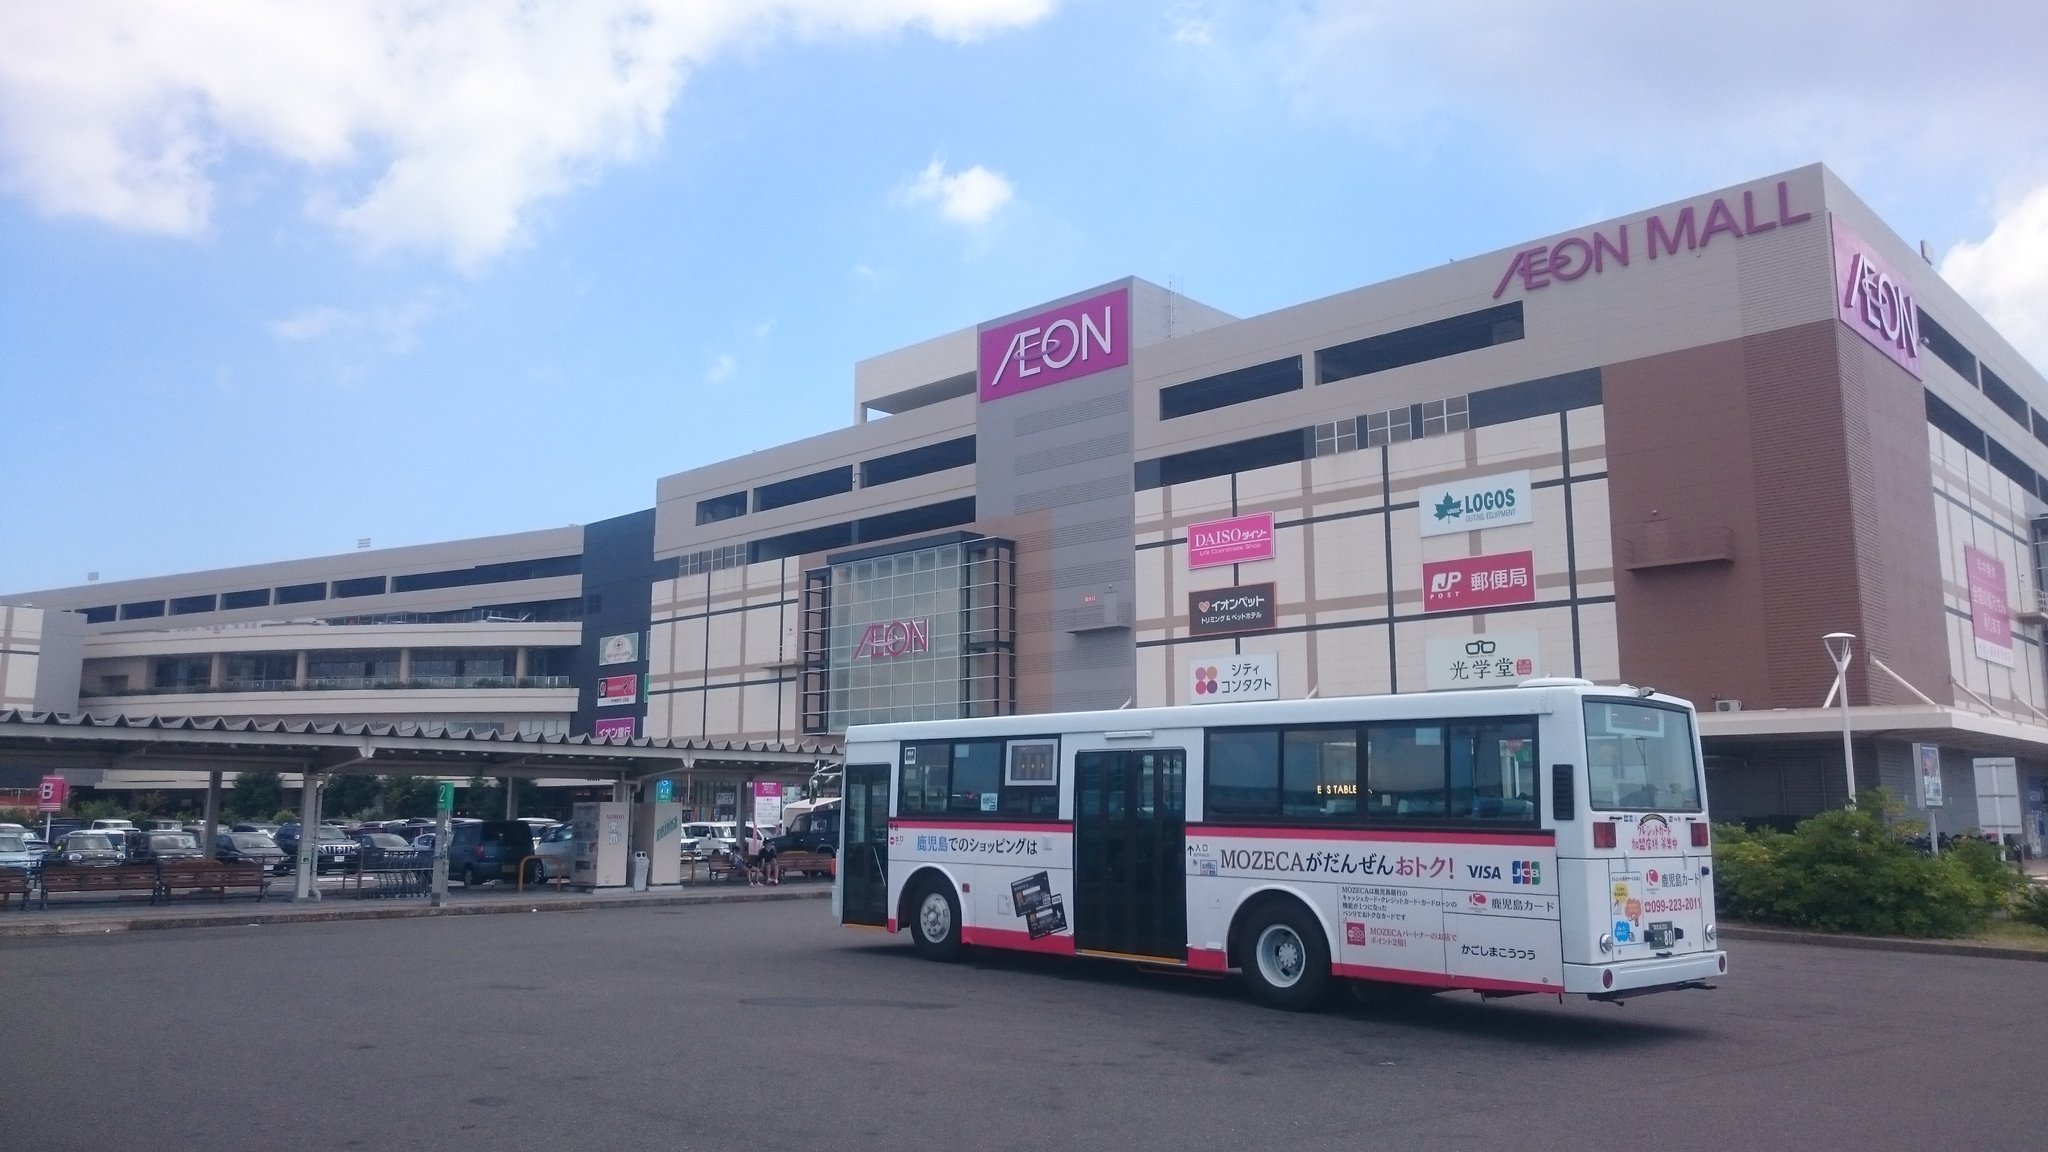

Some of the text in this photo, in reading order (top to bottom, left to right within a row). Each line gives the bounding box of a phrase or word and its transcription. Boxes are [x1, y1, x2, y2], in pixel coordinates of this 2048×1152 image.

[1646, 181, 1811, 260] MALL
[1465, 488, 1516, 514] LOGOS
[1465, 509, 1516, 522] OUTING EQUIPMENT
[1194, 528, 1242, 548] DAISO
[1211, 545, 1244, 555] Coordinate
[1245, 543, 1261, 551] Shop
[1471, 567, 1528, 592] 郵便局
[1211, 595, 1265, 612] イオンペット
[1430, 591, 1460, 600] POST
[1231, 663, 1260, 676] シティ
[1450, 657, 1514, 680] 光学堂
[1221, 677, 1272, 694] コンタクト
[42, 783, 54, 799] B
[440, 785, 446, 802] 2
[917, 835, 1038, 855] 鹿児島でのショッピングは
[1467, 864, 1502, 880] VISA
[1661, 871, 1700, 888] 鹿児島カード
[1491, 898, 1555, 913] 鹿児島カード
[1652, 897, 1701, 913] 099-223-2011
[1461, 944, 1536, 961] かごしまこうつう
